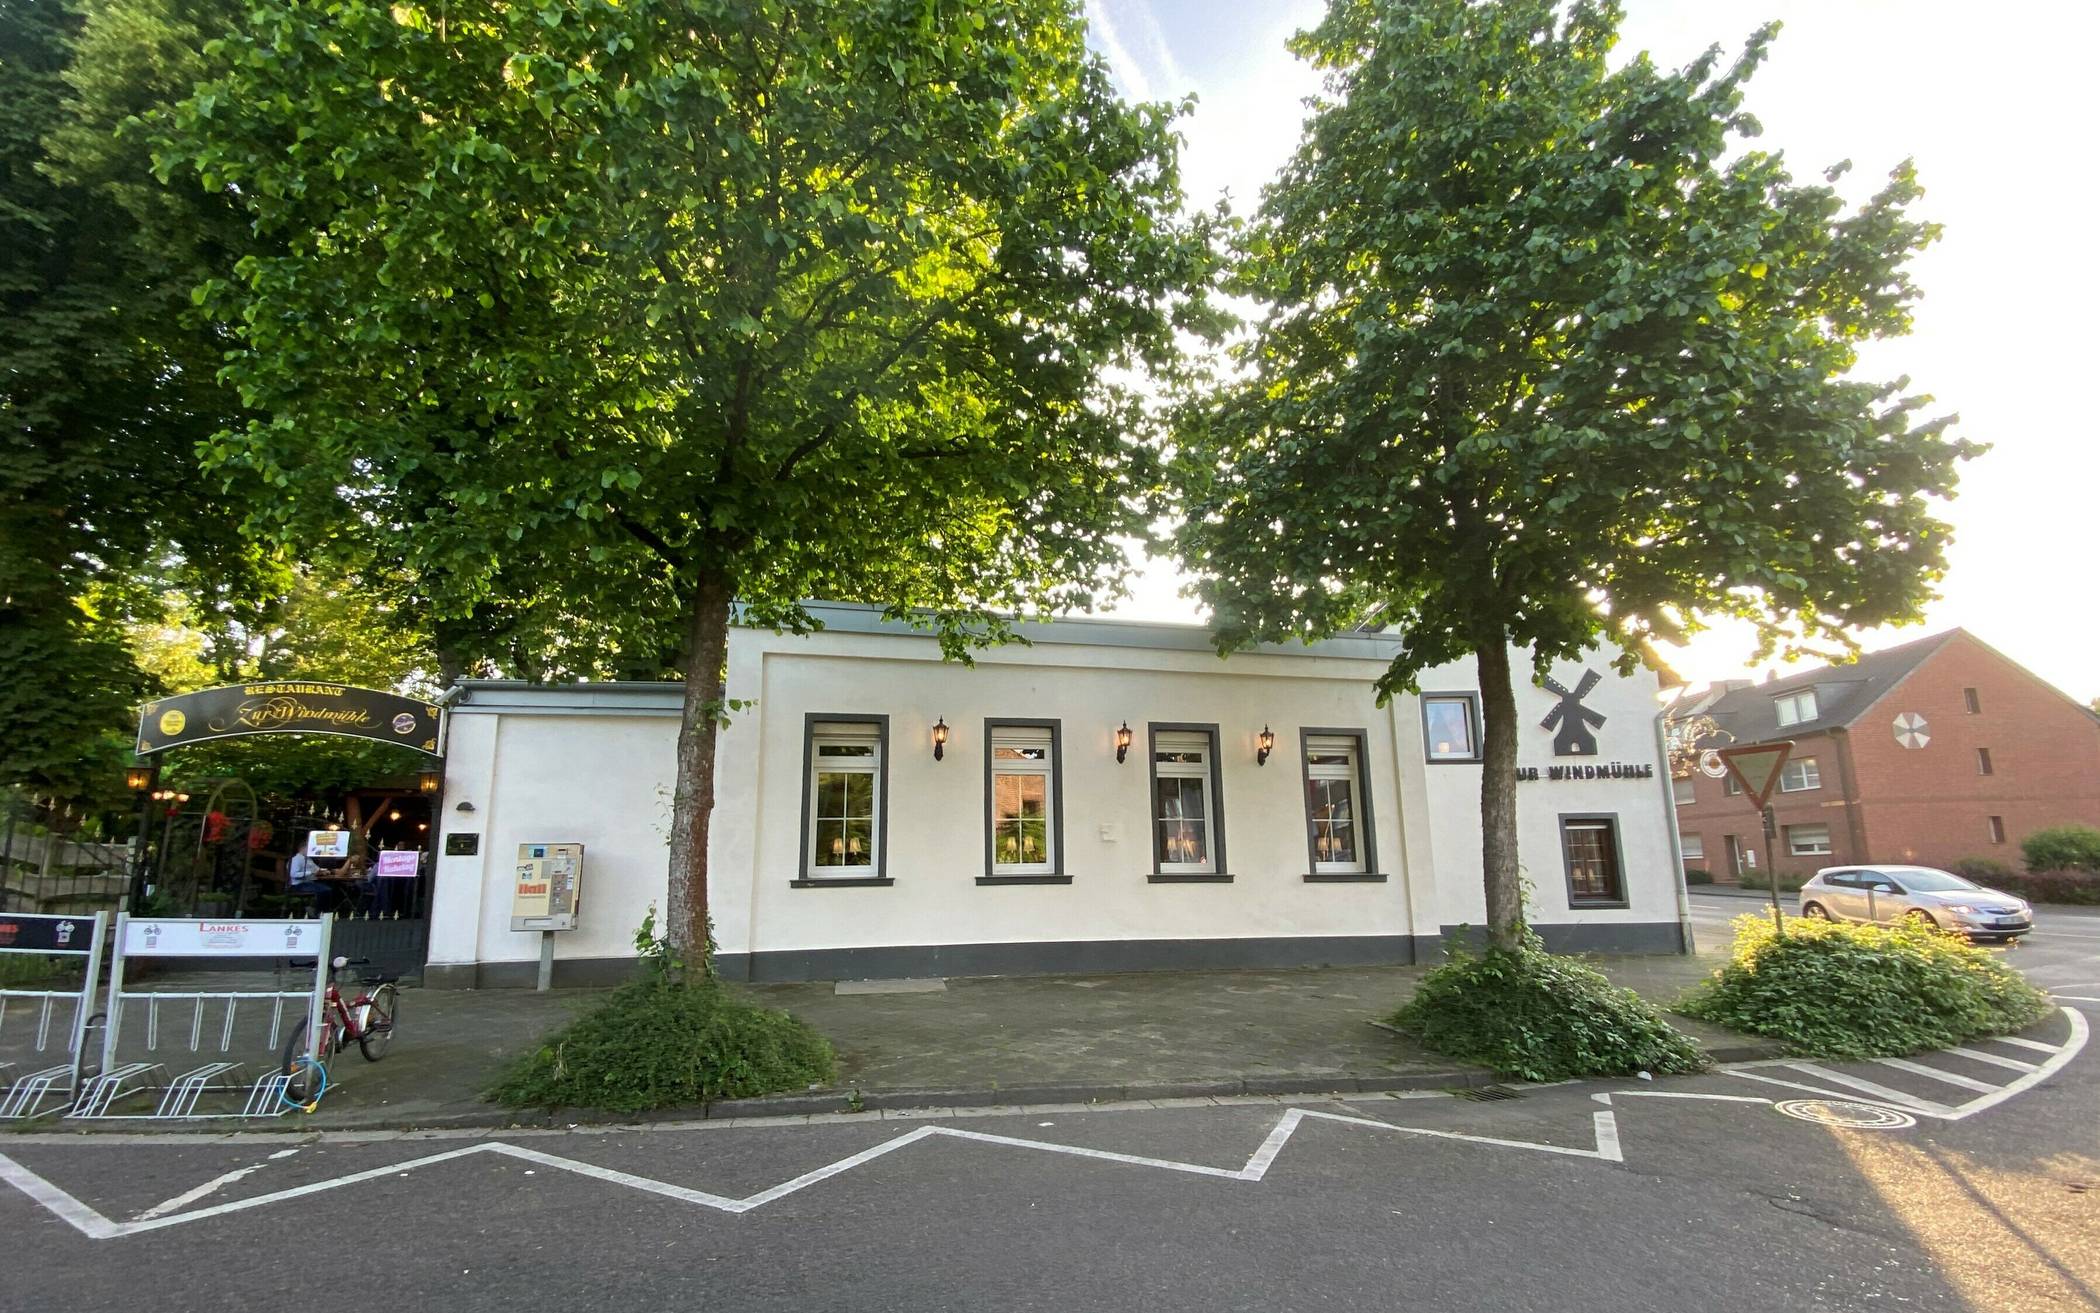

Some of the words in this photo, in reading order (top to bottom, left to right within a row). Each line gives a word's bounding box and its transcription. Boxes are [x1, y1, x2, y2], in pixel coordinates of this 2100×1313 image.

[244, 684, 346, 697] RESTAURANT
[1516, 766, 1539, 781] UR
[1548, 761, 1654, 781] WINDMÜHLE
